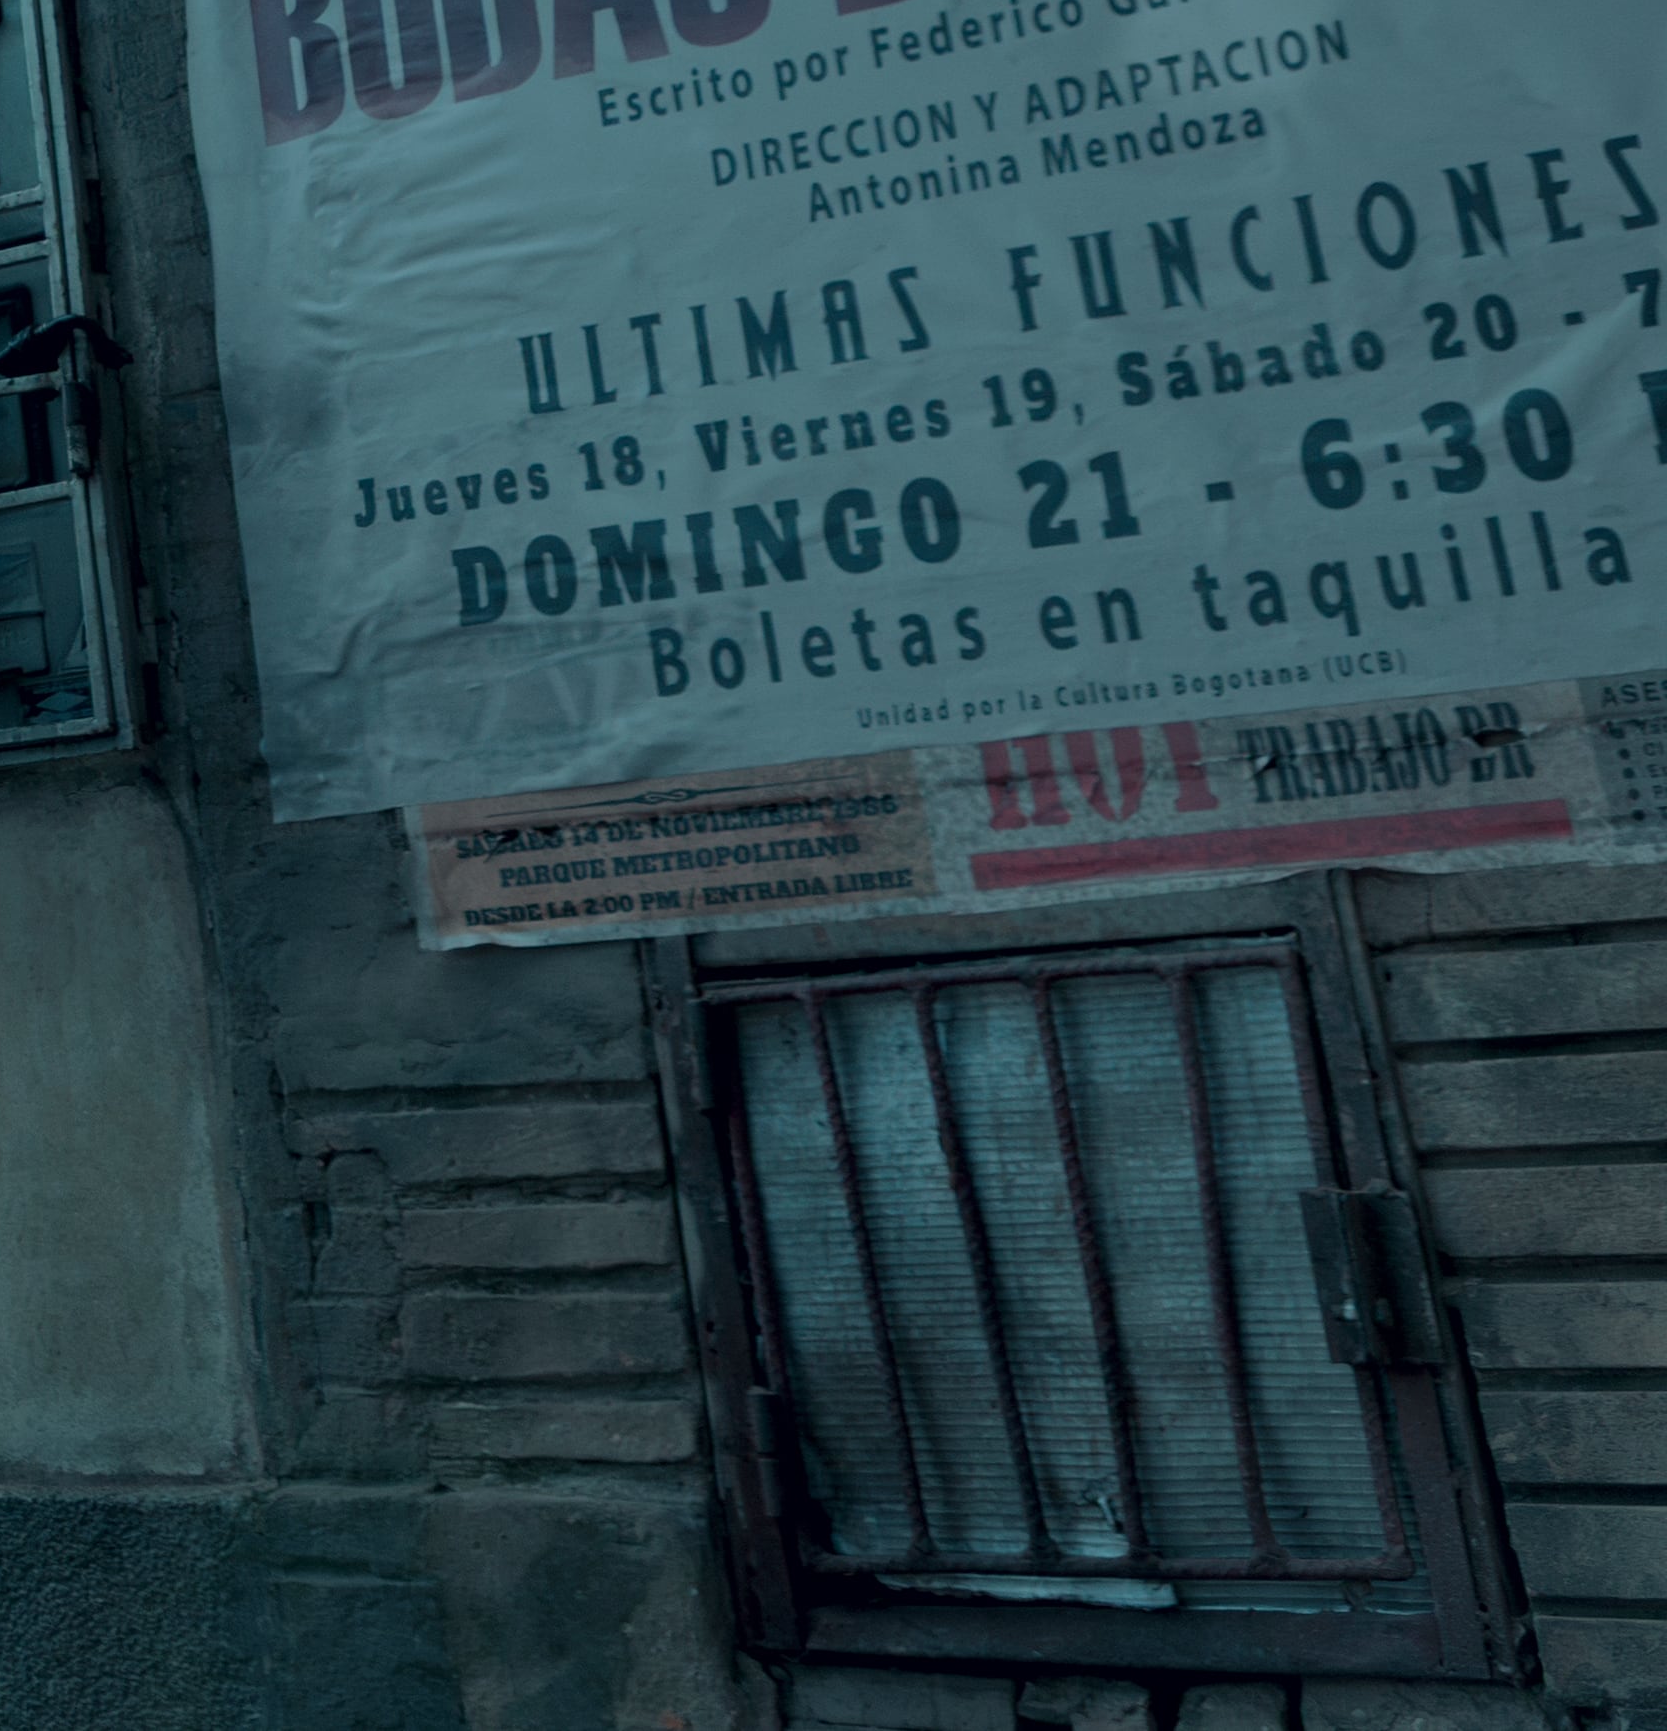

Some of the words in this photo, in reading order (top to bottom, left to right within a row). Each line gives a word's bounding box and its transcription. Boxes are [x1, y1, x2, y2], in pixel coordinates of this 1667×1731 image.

[598, 67, 754, 128] Escrito
[775, 38, 852, 103] por
[710, 98, 958, 188] DIRECCION
[973, 90, 1000, 135] Y
[1024, 20, 1352, 129] ADAPTACION
[807, 146, 1022, 223] Antonina
[1041, 106, 1268, 182] Mendoza
[516, 266, 931, 415] ULTIMAS
[1007, 134, 1660, 332] FUNCIONES
[354, 462, 551, 528] Jueves
[577, 434, 666, 492] 18,
[693, 397, 951, 472] Viernes
[982, 366, 1086, 428] 19,
[1116, 322, 1385, 408] Sábado
[1423, 293, 1517, 361] 20
[1622, 268, 1661, 328] 7
[451, 476, 962, 628] DOMINGO
[1017, 450, 1141, 549] 21
[1299, 387, 1573, 510] 6:30
[648, 605, 986, 698] Boletas
[1040, 583, 1143, 651] en
[1193, 510, 1633, 637] taquilla
[857, 698, 950, 729] Unidad
[963, 696, 1005, 724] por
[1017, 689, 1043, 712] la
[1055, 681, 1160, 708] Cultura
[1171, 663, 1311, 697] Bogotana
[1322, 647, 1408, 684] (UCB)
[464, 902, 543, 927] DESDE
[547, 899, 577, 919] LA
[639, 889, 681, 912] PM
[703, 875, 829, 906] ENTRADA
[833, 868, 914, 894] LIBRE
[499, 856, 607, 888] PARQUE
[613, 832, 862, 877] METROPOLITANO
